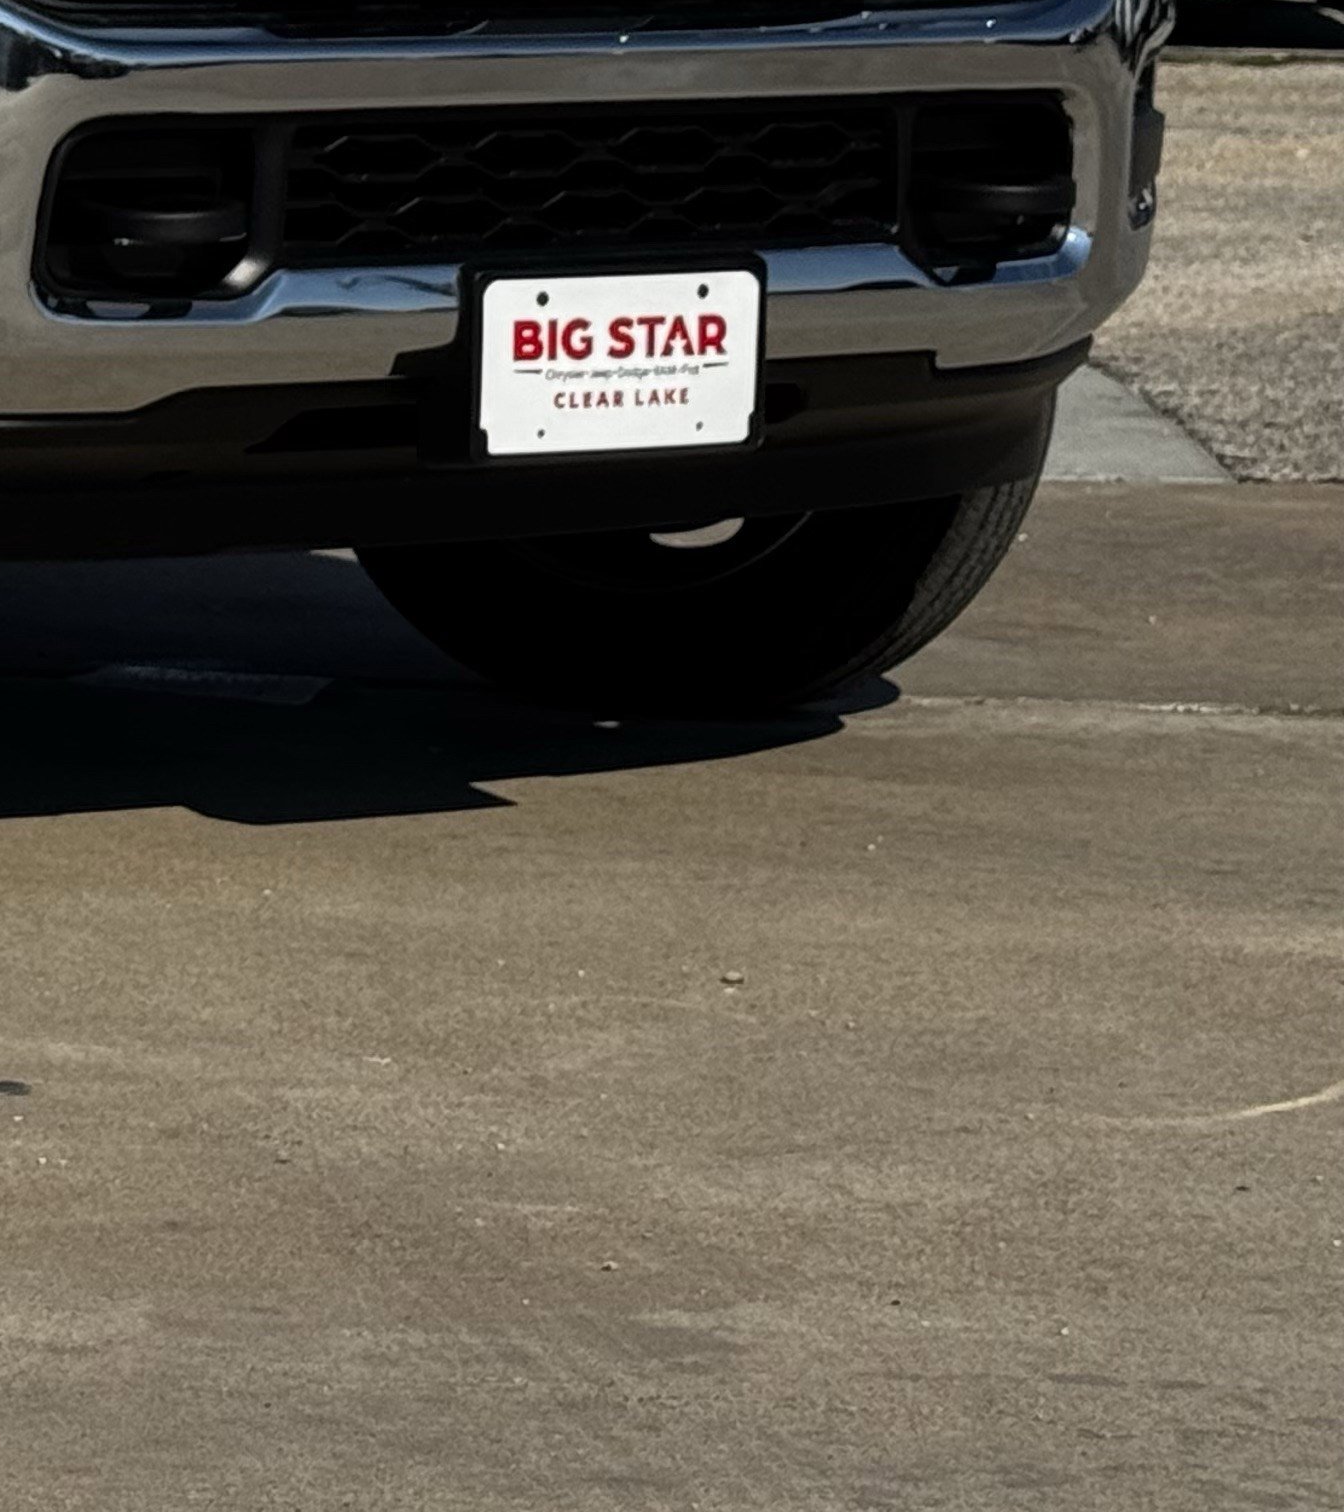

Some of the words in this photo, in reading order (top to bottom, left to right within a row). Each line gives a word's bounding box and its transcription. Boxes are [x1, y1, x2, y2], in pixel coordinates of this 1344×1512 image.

[513, 318, 593, 361] BIG
[608, 314, 727, 359] STAR
[553, 391, 624, 409] CLEAR
[634, 387, 690, 406] LAKE
